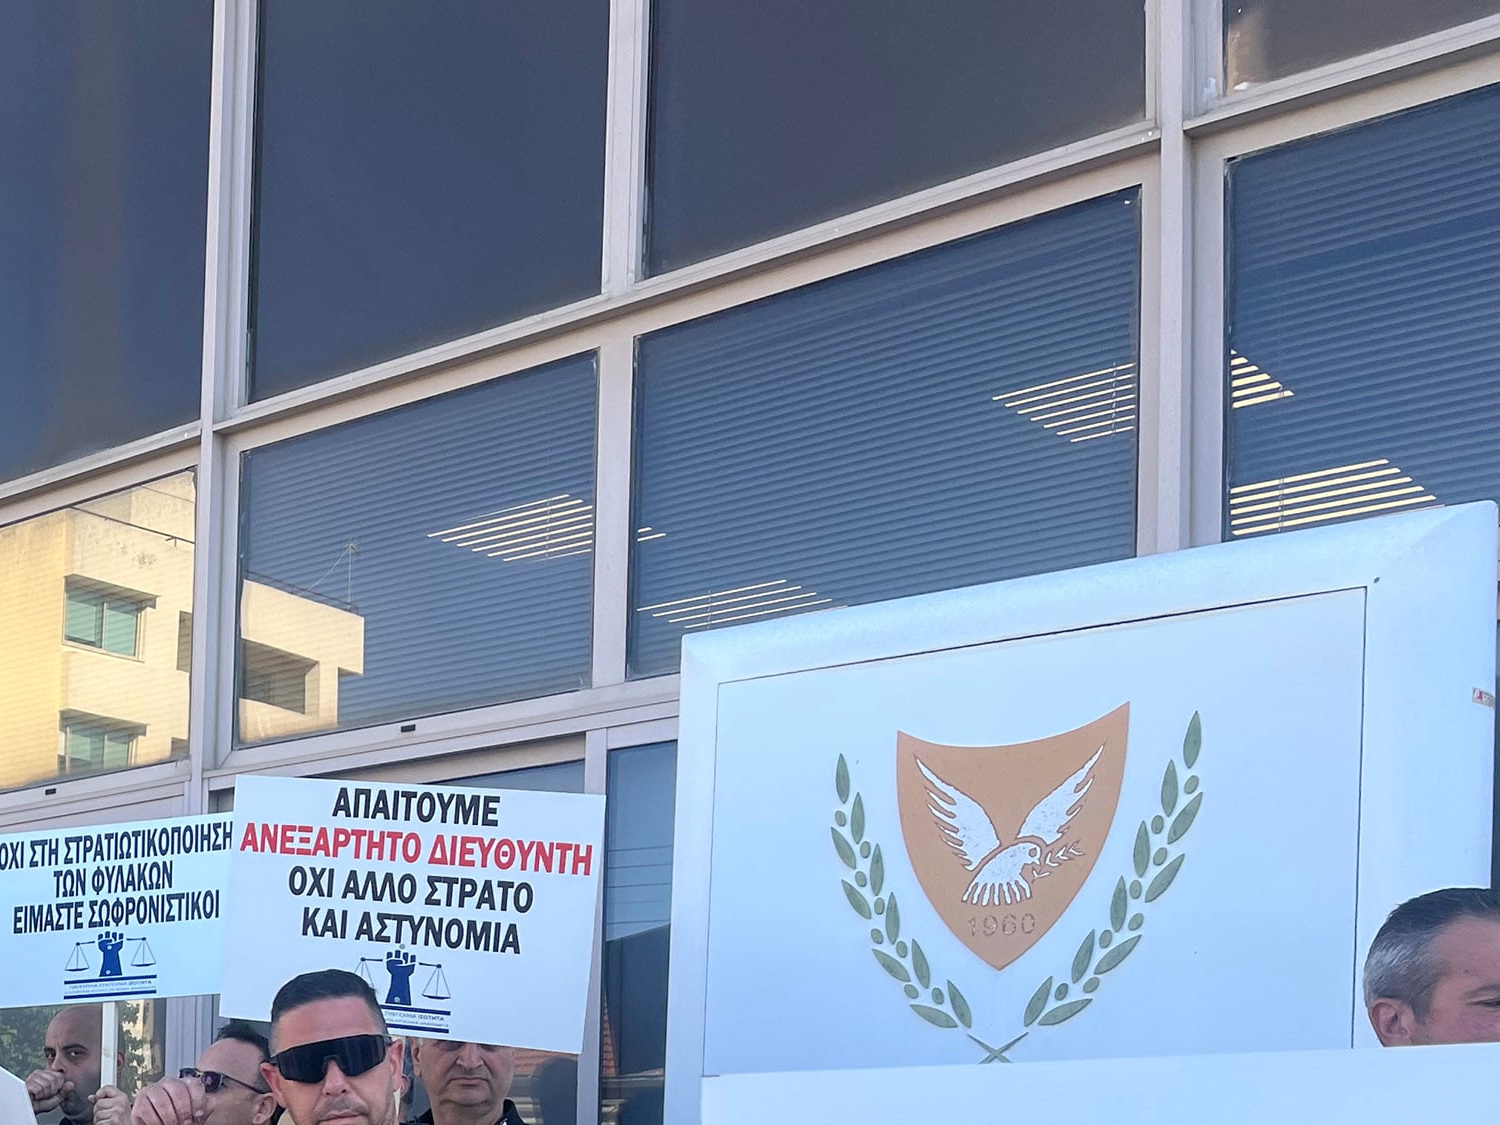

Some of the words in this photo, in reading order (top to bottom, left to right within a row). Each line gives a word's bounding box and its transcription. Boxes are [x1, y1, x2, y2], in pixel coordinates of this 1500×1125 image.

[332, 787, 501, 827] ΑΠΑΙΤΟΥΜΕ
[29, 838, 60, 868] ΣΤΗ
[63, 821, 233, 865] ΣΤΡΑΤΙΩΤΙΚΟΠΟΙΗΣΗ
[240, 822, 422, 864] ΑΝΕΞΑΡΤΗΤΟ
[428, 834, 594, 877] ΔΙΕΥΘΥΝΤΗ
[53, 868, 87, 898] ΤΩΝ
[92, 860, 173, 896] ΦΥΛΑΚΩΝ
[289, 865, 335, 898] ΟΧΙ
[341, 869, 417, 904] ΑΛΛΟ
[424, 875, 534, 914] ΣΤΡΑΤΟ
[13, 899, 84, 934] ΕΙΜΑΣΤΕ
[88, 889, 220, 928] ΣΩΦΡΟΝΙΣΤΙΚΟΙ
[301, 907, 348, 939] ΚΑΙ
[355, 912, 521, 954] ΑΣΤΥΝΟΜΙΑ
[968, 912, 1037, 937] 1960
